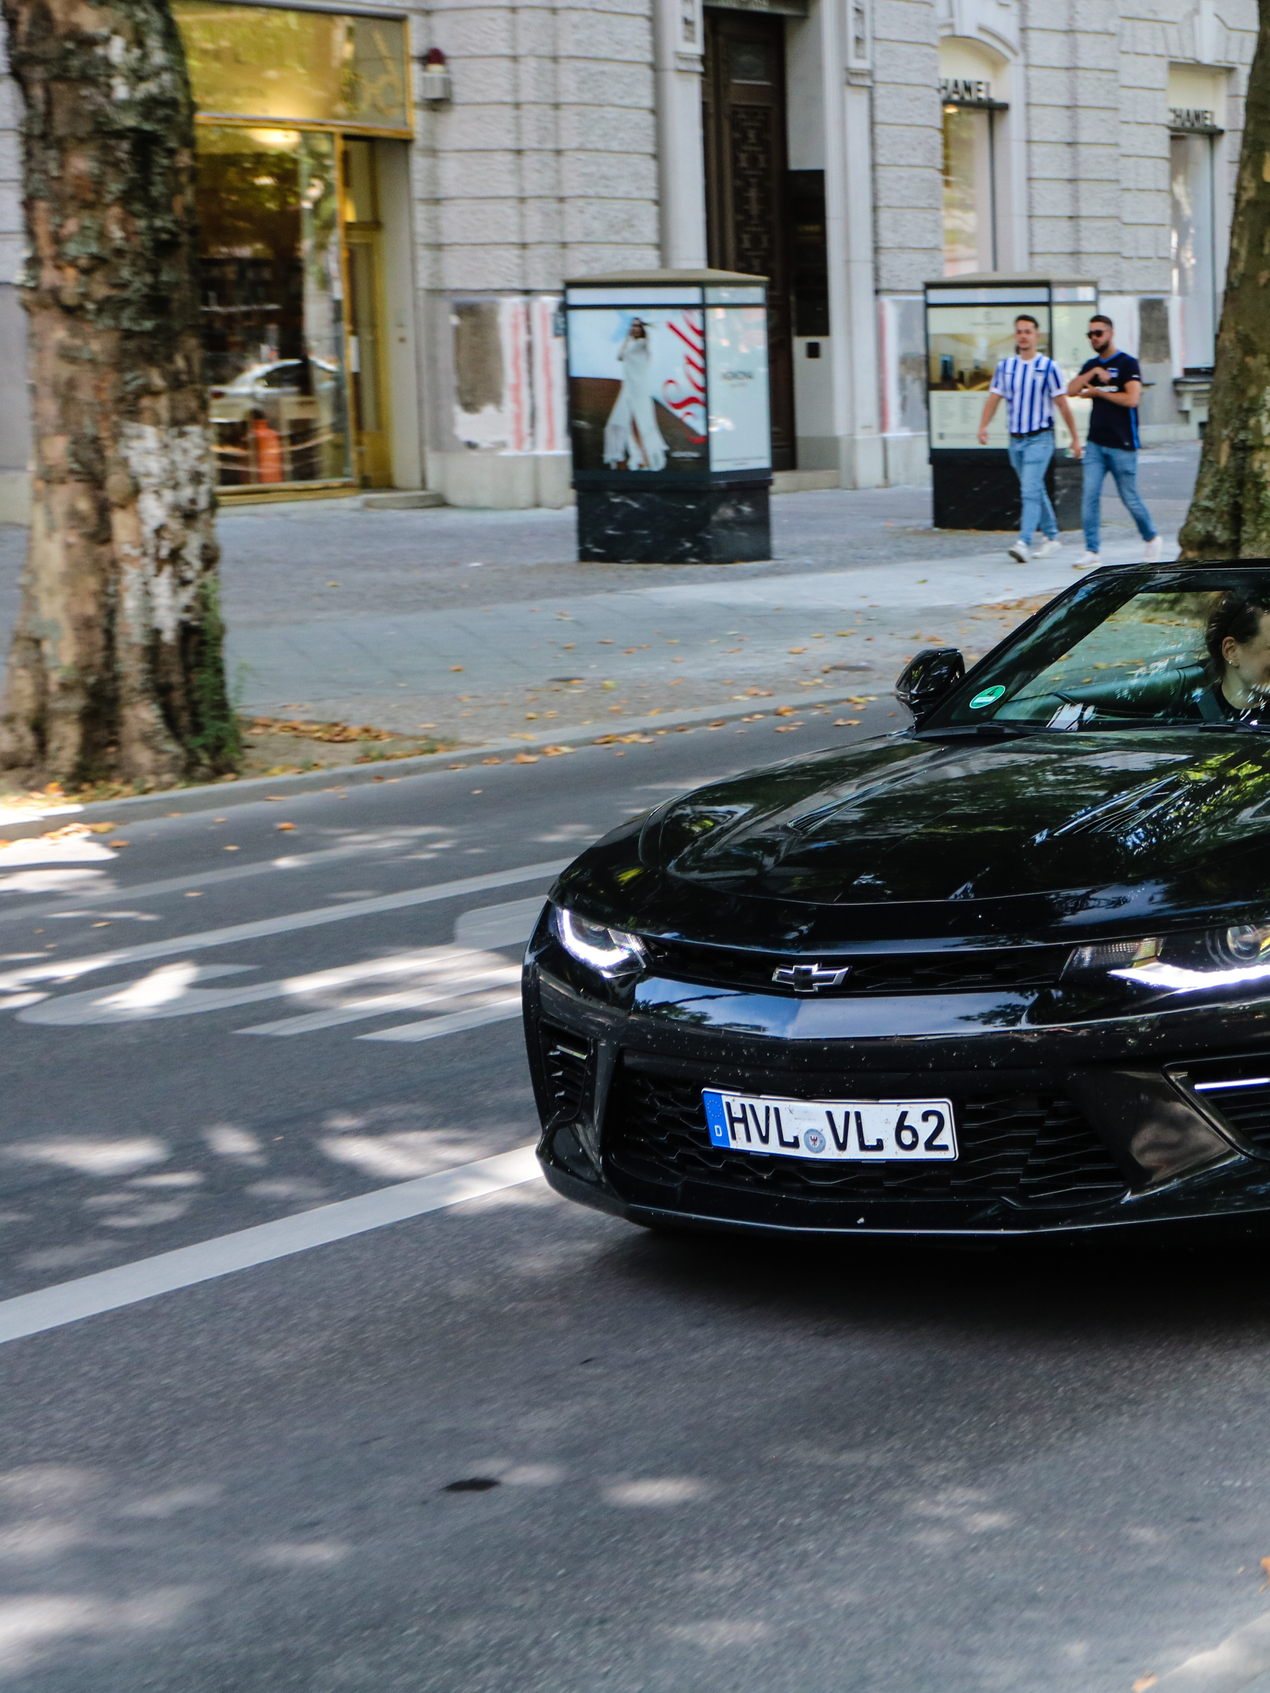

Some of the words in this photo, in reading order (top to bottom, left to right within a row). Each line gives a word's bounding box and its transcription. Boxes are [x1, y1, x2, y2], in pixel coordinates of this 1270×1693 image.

[938, 78, 993, 102] HANEL
[714, 1125, 723, 1137] D
[725, 1101, 800, 1149] HVL
[825, 1110, 884, 1152] VL
[895, 1110, 949, 1151] 62
